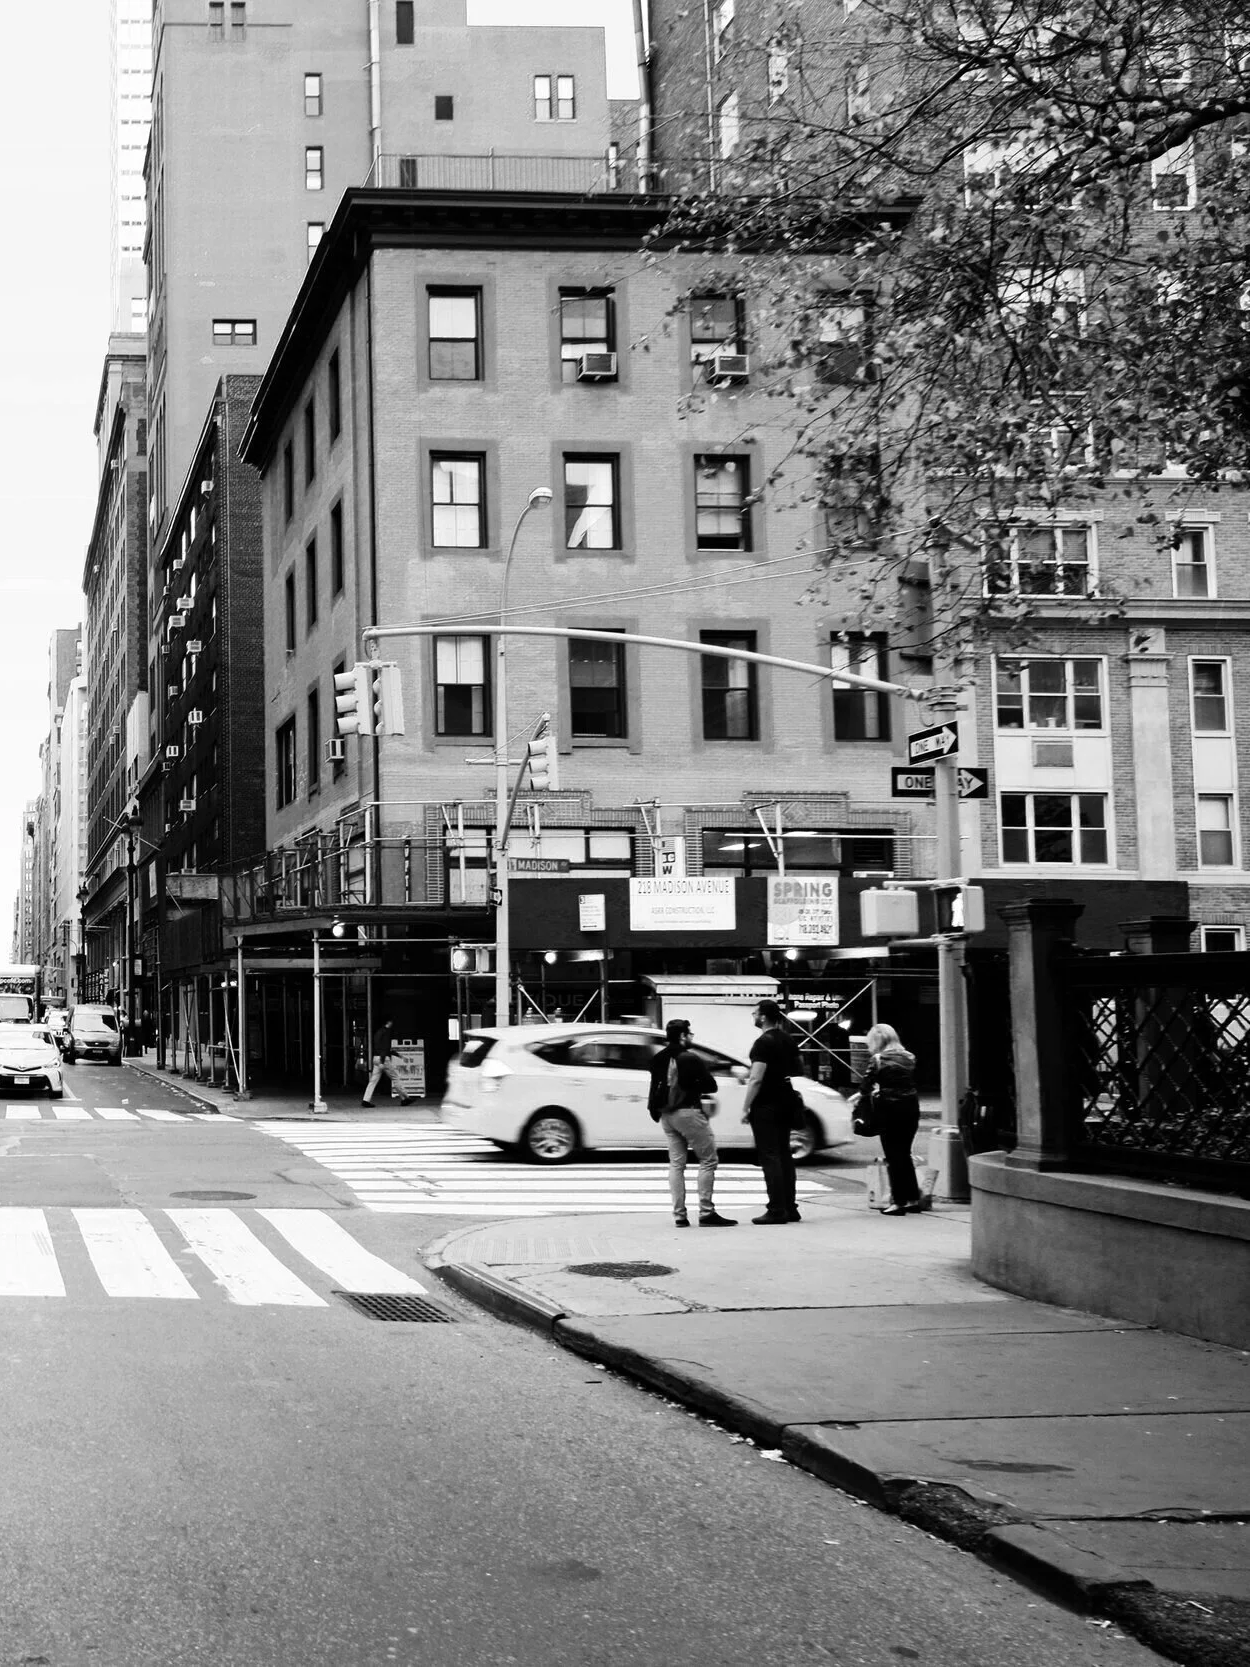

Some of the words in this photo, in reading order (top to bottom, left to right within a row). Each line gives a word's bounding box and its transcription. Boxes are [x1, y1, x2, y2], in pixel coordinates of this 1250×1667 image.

[915, 739, 929, 755] ONE
[935, 734, 950, 747] WAY
[905, 776, 934, 789] ONE
[517, 860, 558, 871] MADISON
[638, 880, 651, 894] 218
[653, 880, 693, 894] MADISON
[696, 880, 729, 894] AVENUE
[773, 882, 833, 898] SPRING
[821, 1001, 840, 1009] Photo
